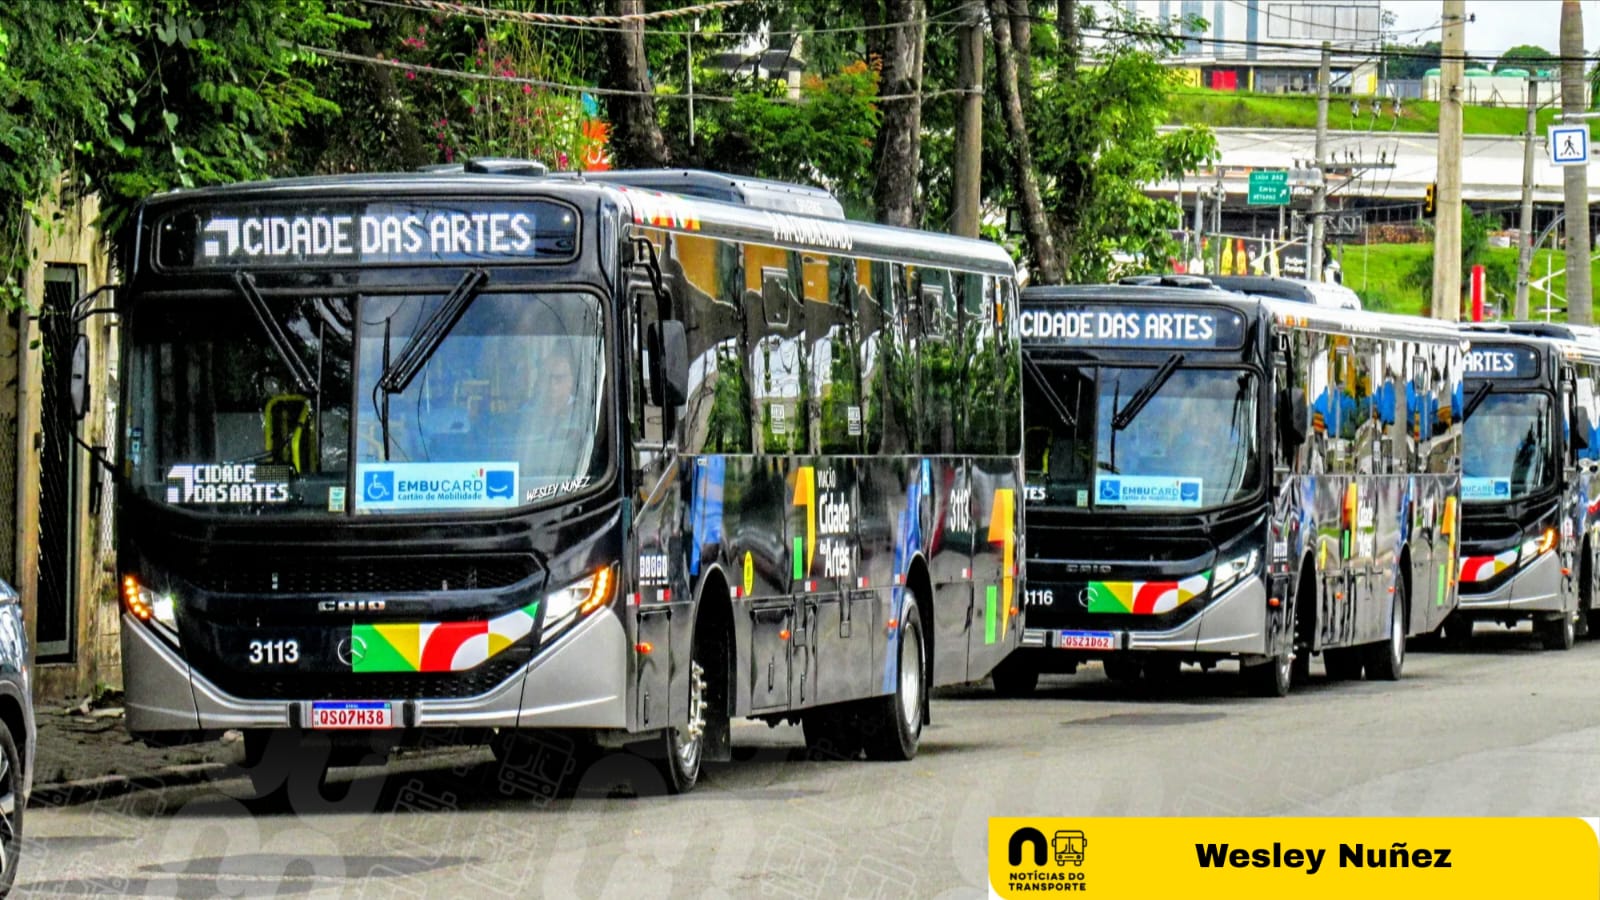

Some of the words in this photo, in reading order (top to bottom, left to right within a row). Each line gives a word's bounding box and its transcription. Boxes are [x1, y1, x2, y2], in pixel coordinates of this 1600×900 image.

[243, 216, 353, 255] CIDADE
[361, 215, 422, 253] DAS
[430, 213, 531, 252] ARTES
[1020, 312, 1093, 337] CIDADE
[1099, 313, 1140, 338] DAS
[1145, 314, 1213, 340] ARTES
[1462, 351, 1514, 371] ARTES
[194, 464, 256, 483] CIDADE
[194, 484, 228, 502] DAS
[229, 482, 289, 502] ARTES
[398, 480, 483, 492] EMBUCARD
[438, 492, 482, 500] Mobilidade
[1122, 487, 1179, 496] EMBUCARD
[819, 492, 850, 533] Cidade
[950, 489, 969, 532] 3113
[825, 538, 850, 578] Artes
[249, 640, 298, 663] 3113
